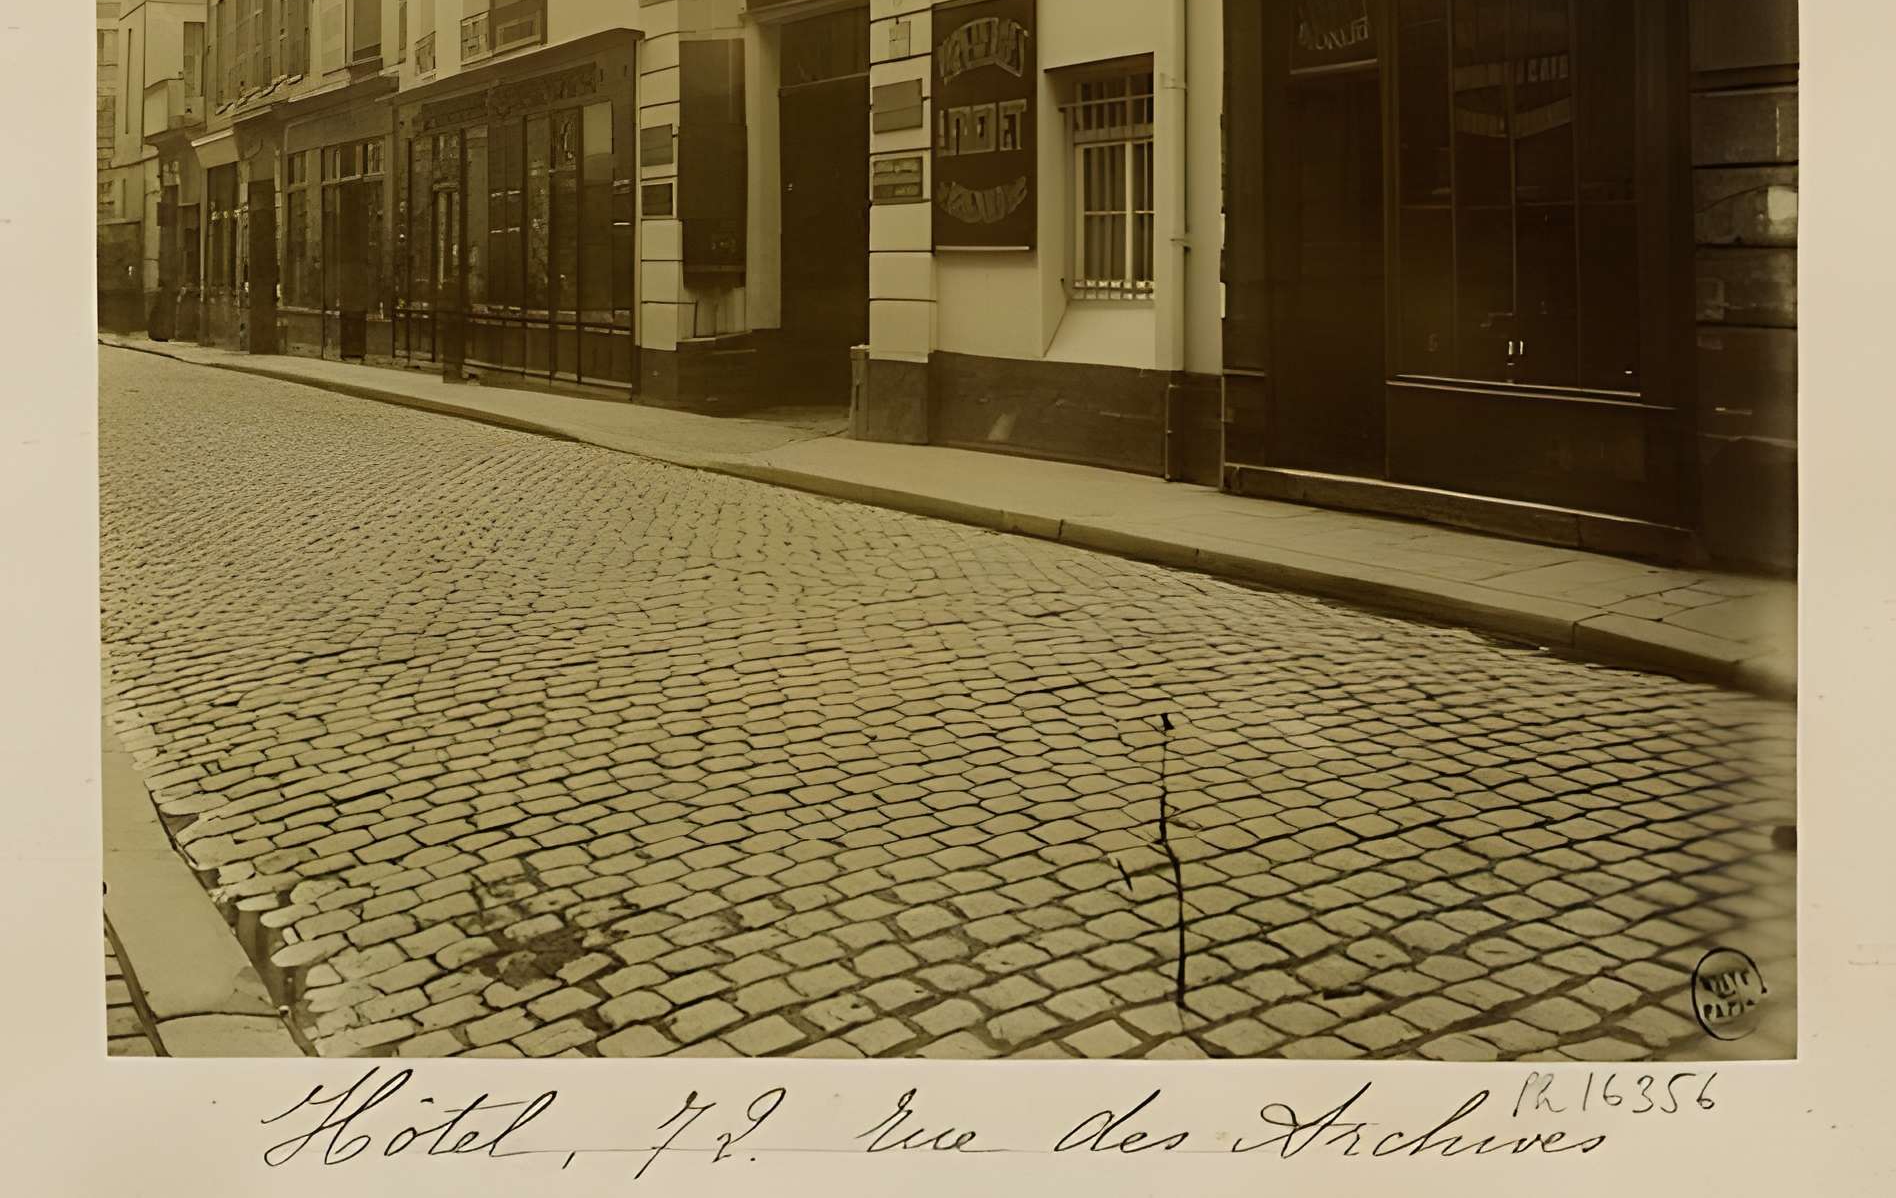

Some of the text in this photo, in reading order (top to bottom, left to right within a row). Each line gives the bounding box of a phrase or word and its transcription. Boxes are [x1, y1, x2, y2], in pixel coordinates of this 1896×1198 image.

[1053, 1087, 1190, 1154] des
[1231, 1081, 1608, 1159] Archives
[1582, 1071, 1719, 1114] 16356
